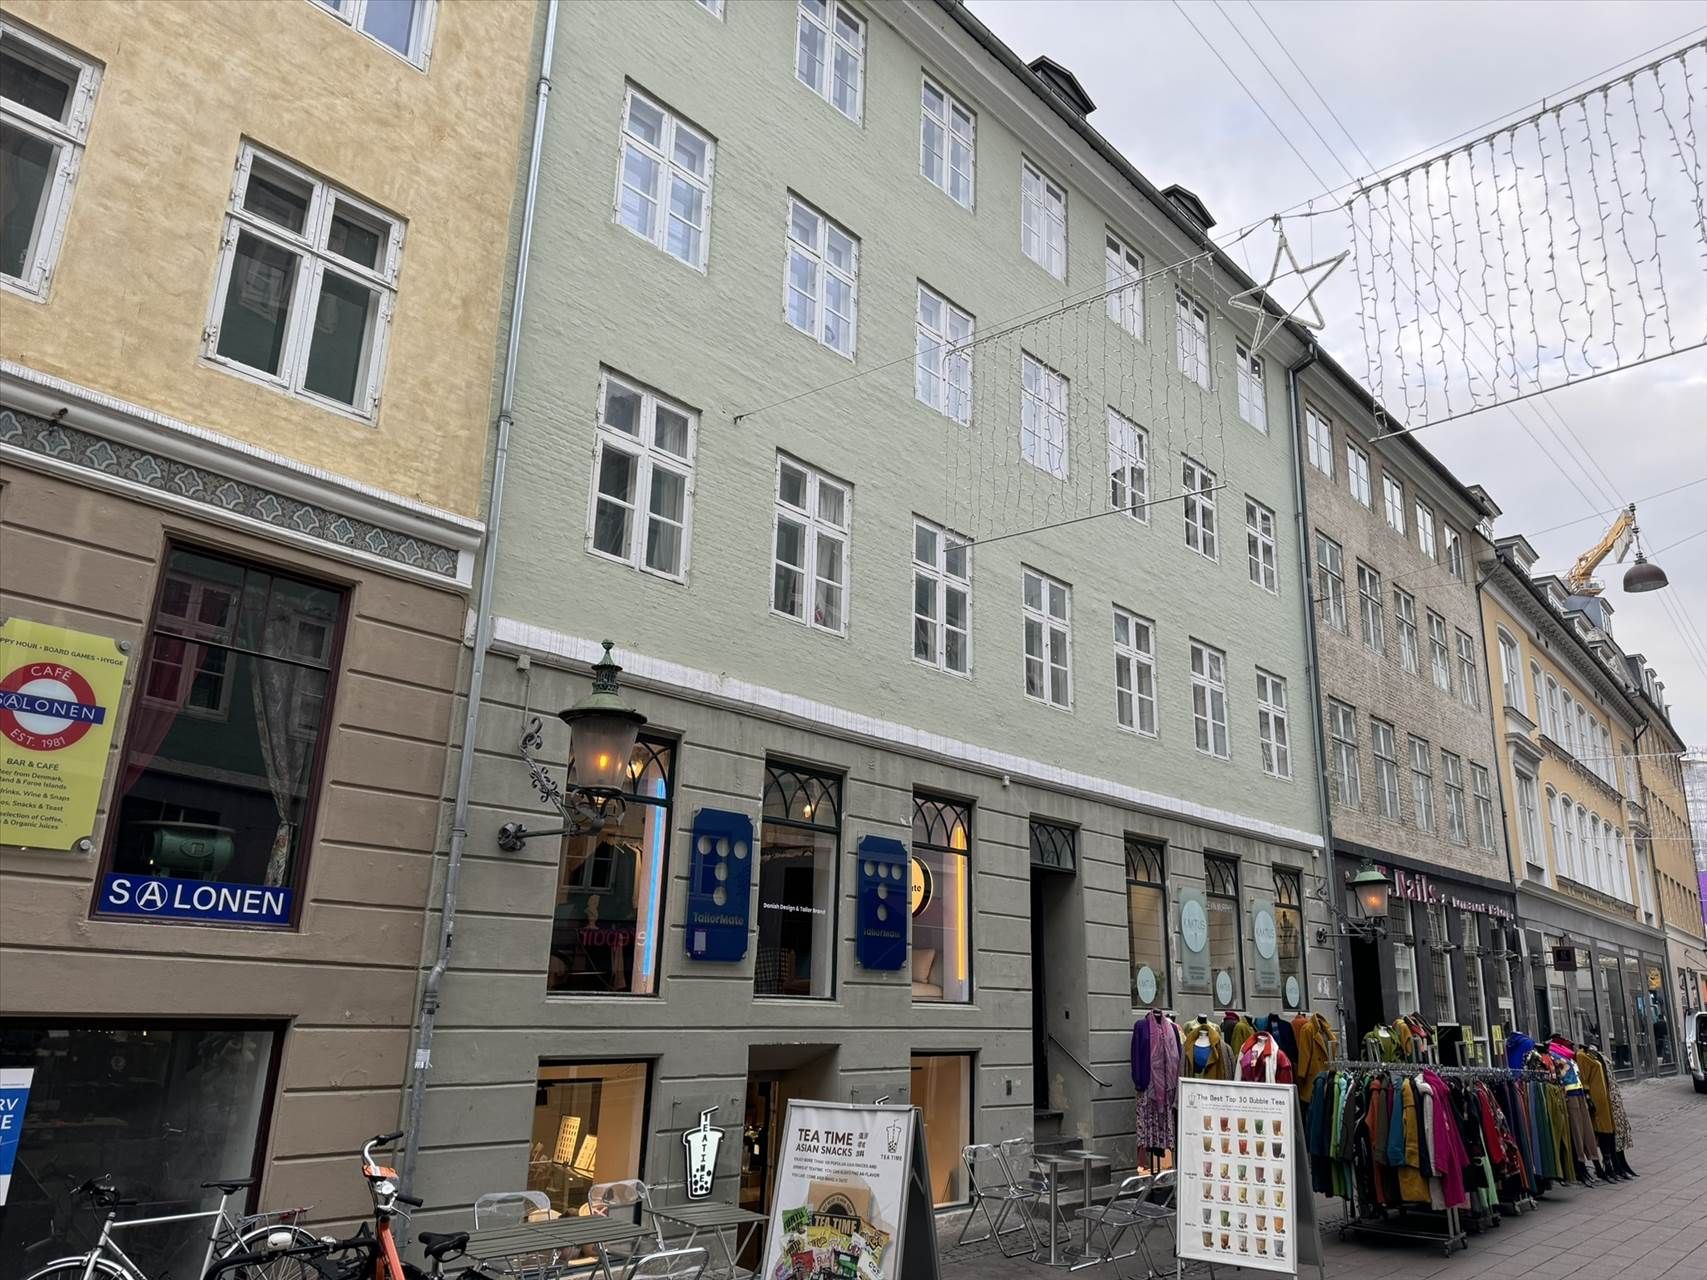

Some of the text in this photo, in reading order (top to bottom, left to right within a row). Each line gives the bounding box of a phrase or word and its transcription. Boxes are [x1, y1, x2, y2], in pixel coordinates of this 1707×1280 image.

[16, 640, 38, 650] HOUR
[43, 645, 69, 656] BOARD
[71, 652, 95, 661] GAMES
[100, 656, 123, 666] HYGGE
[31, 666, 72, 681] CAFÉ
[10, 728, 66, 748] EST. 1981
[6, 757, 26, 766] BAR
[13, 770, 30, 778] from
[43, 782, 67, 790] Islands
[23, 790, 41, 798] Wine
[12, 801, 36, 809] Snacks
[10, 820, 38, 828] Organic
[108, 878, 284, 916] SALONEN
[779, 903, 796, 912] Design
[693, 912, 745, 926] TailorMate
[1210, 1094, 1223, 1102] Best
[1226, 1095, 1237, 1103] Top
[1249, 1097, 1269, 1105] Bubble
[798, 1128, 820, 1143] TEA
[824, 1130, 853, 1146] TIME
[795, 1143, 853, 1157] ASIAN SNACKS
[814, 1215, 831, 1228] TEA
[833, 1217, 857, 1236] TIME
